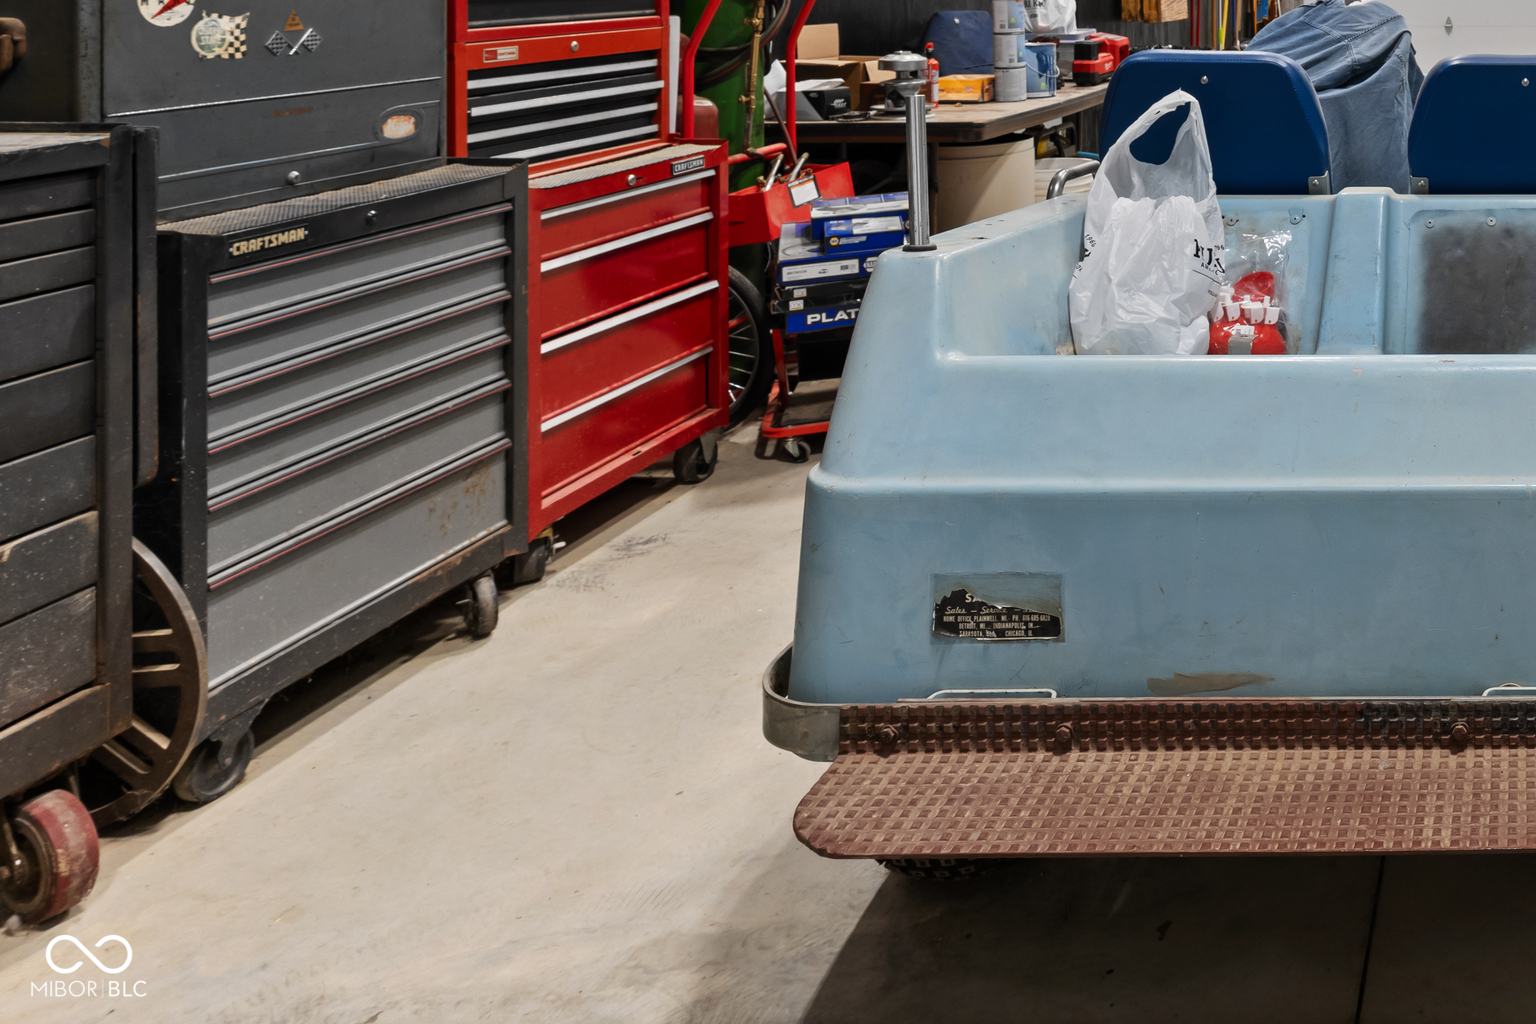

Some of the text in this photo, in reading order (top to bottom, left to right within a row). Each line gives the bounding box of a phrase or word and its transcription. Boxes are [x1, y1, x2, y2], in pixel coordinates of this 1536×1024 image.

[674, 158, 703, 172] CRAFTSMAN
[232, 227, 305, 256] CRAFTSMAN
[945, 606, 967, 615] Sales
[943, 615, 956, 623] HOME
[957, 615, 973, 623] OFFICE
